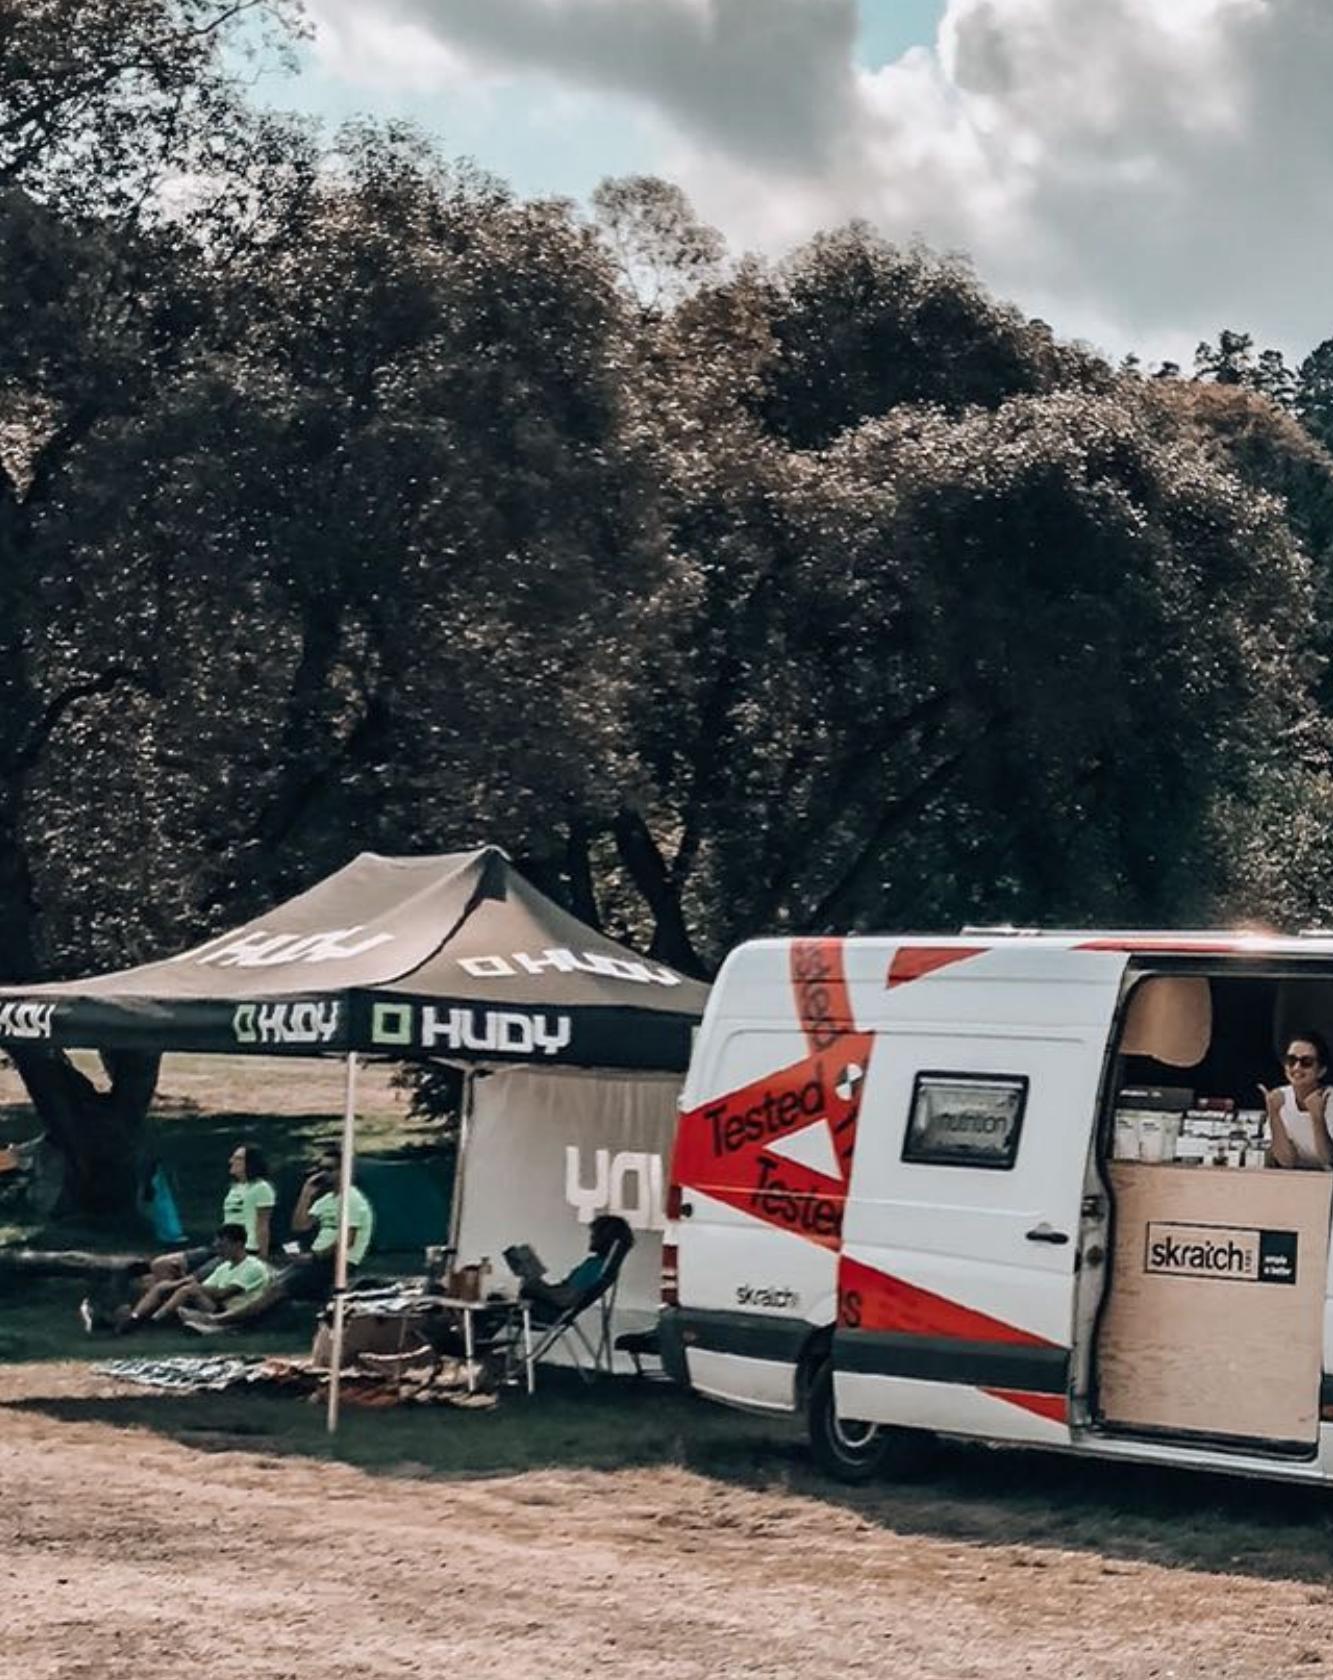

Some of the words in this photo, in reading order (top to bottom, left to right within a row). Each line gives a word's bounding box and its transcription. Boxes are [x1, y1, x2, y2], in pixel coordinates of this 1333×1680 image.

[512, 947, 682, 986] HUDY
[257, 1001, 339, 1043] HUDY
[421, 1005, 572, 1055] HUDY
[704, 1058, 826, 1159] Tested
[752, 1156, 843, 1239] Teste
[1152, 1236, 1243, 1271] skratch
